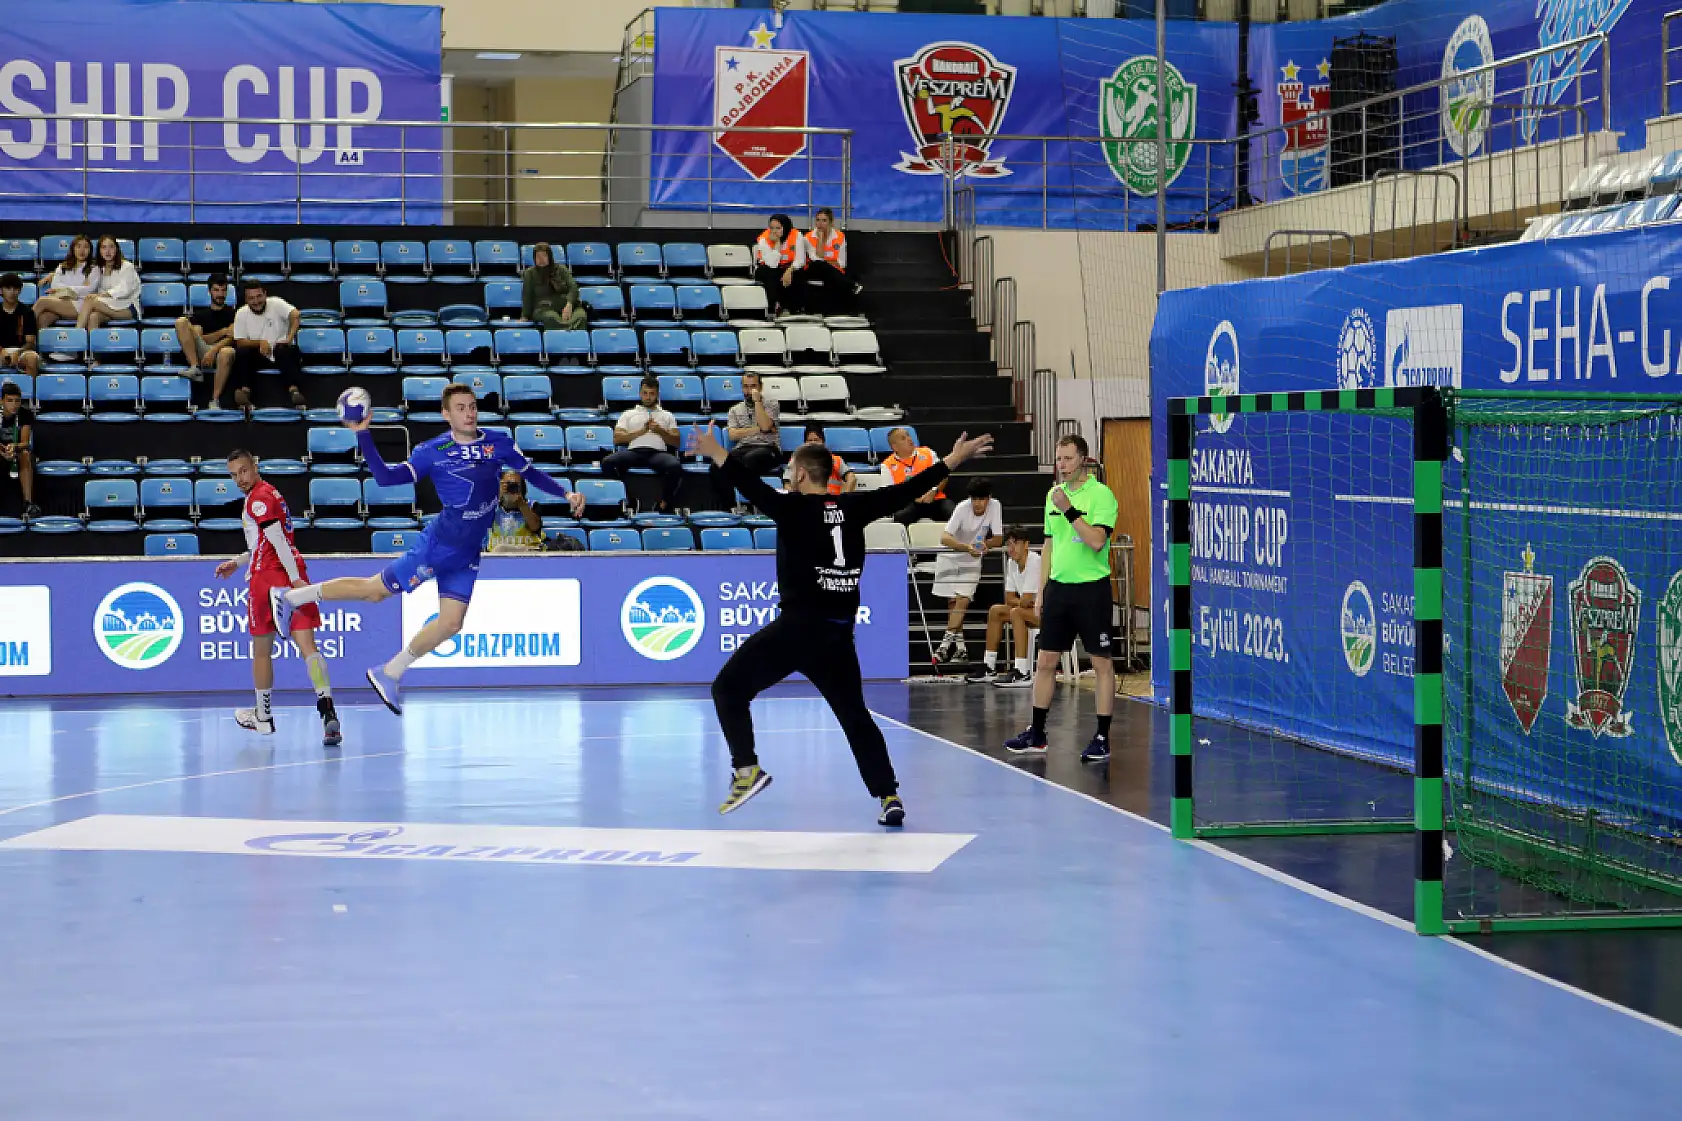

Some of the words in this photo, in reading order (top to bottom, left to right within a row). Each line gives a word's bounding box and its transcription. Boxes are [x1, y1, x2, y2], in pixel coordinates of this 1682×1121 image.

[0, 59, 190, 161] SHIP
[223, 64, 383, 164] CUP
[340, 151, 359, 162] A4
[1500, 275, 1682, 383] SEHA-G
[460, 445, 481, 460] 35
[1191, 448, 1255, 485] SAKARYA
[830, 525, 846, 567] 1
[1163, 499, 1250, 563] FNDSHIP
[1254, 506, 1288, 568] CUP
[463, 632, 560, 658] GAZPROM
[1200, 605, 1240, 658] Eylül
[1243, 612, 1289, 663] 2023.
[370, 844, 701, 863] GAZPROM
